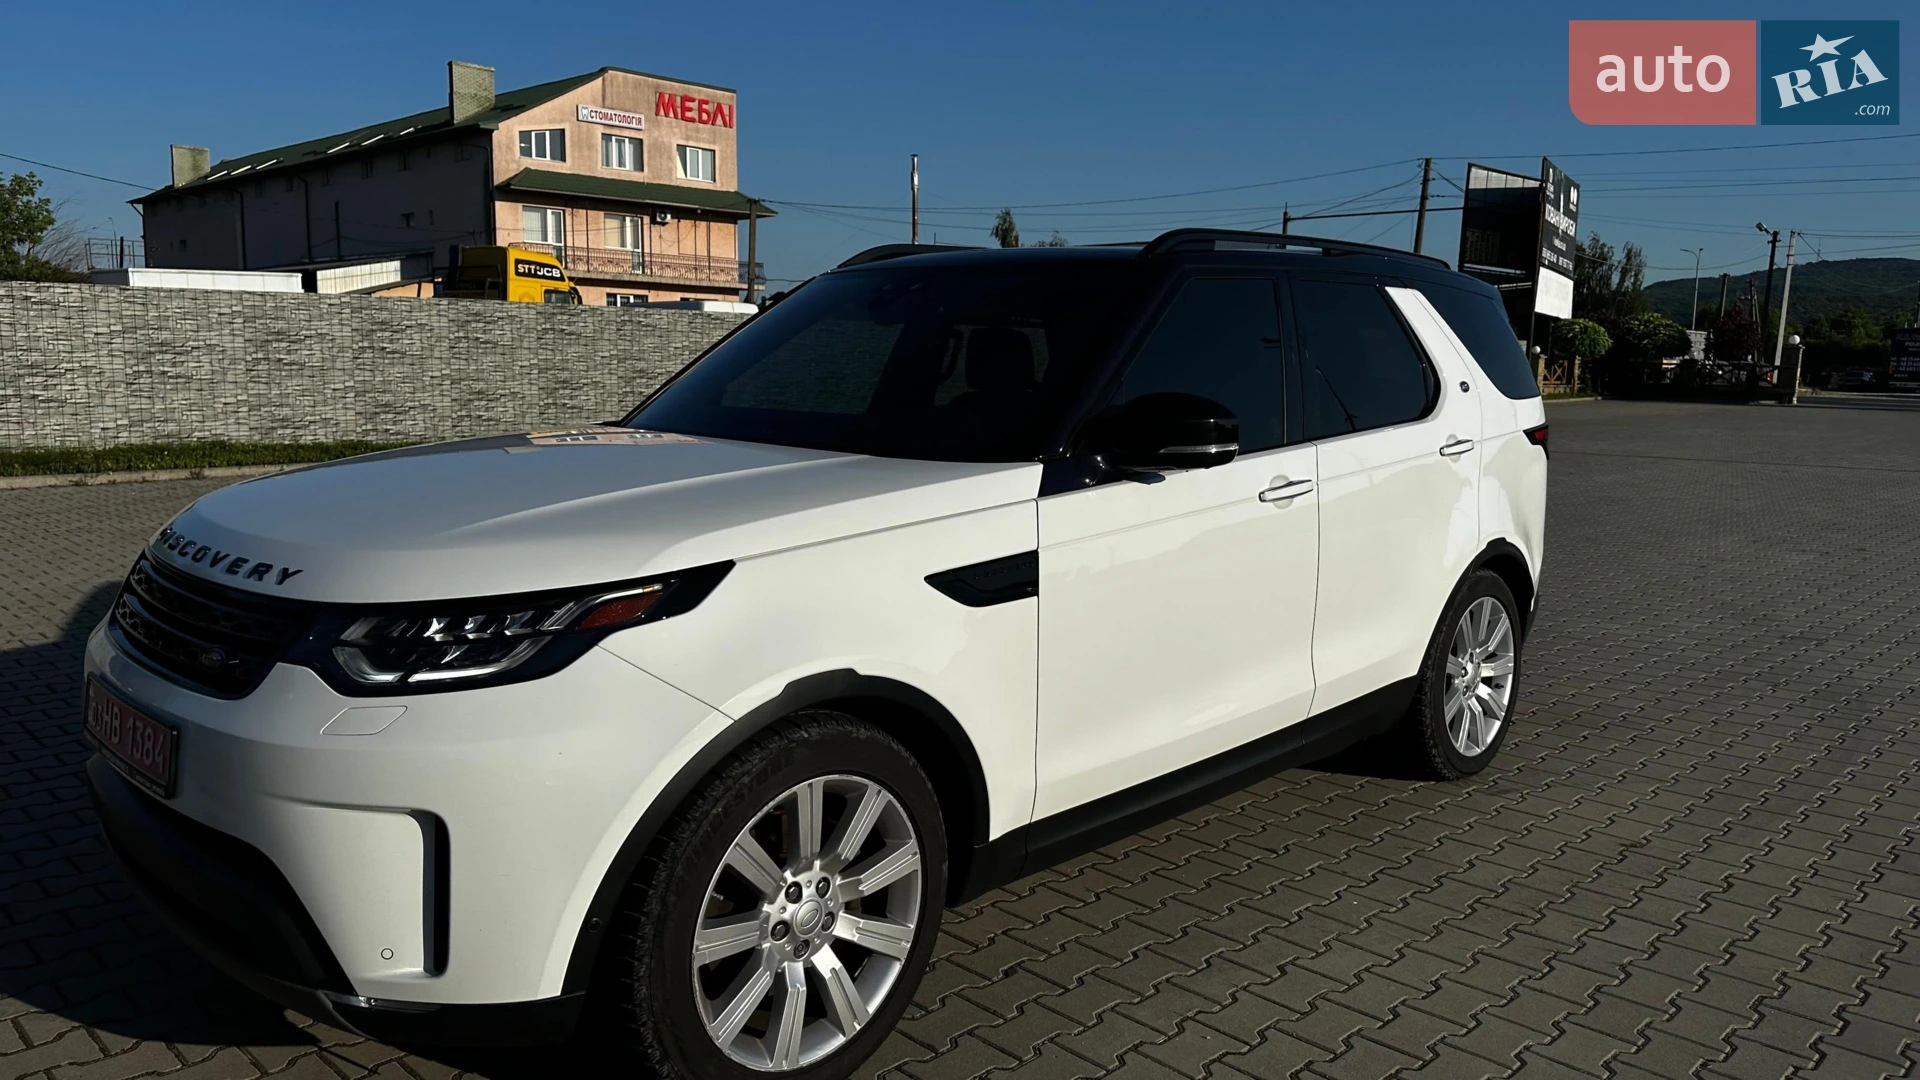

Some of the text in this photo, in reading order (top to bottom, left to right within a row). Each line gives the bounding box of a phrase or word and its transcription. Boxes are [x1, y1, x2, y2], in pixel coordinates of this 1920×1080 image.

[589, 109, 643, 127] СТОМАТОЛОГІЯ
[655, 91, 735, 129] МЕБЛІ
[158, 525, 303, 586] DISCOVERY
[127, 716, 167, 775] 1384
